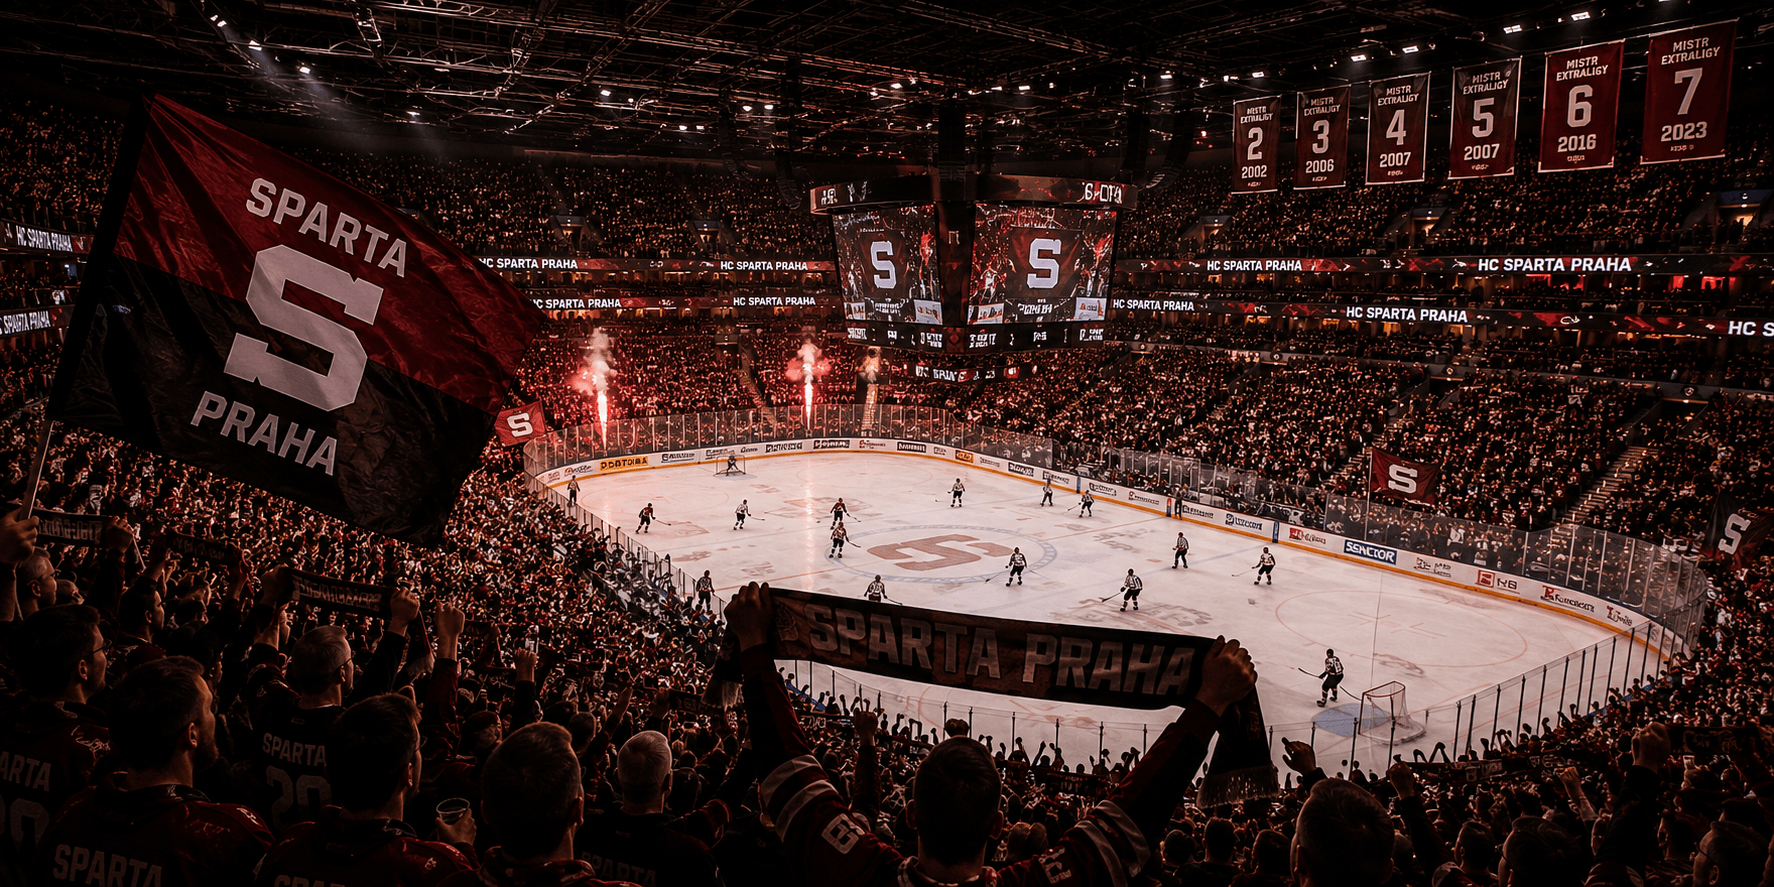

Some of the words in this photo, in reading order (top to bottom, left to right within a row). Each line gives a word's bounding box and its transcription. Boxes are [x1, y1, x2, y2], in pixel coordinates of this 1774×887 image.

[1672, 37, 1710, 52] MISTR
[1566, 55, 1599, 70] MISTR
[1660, 46, 1721, 66] EXTRALIGY
[1385, 85, 1412, 97] MISTR
[1674, 67, 1703, 115] 7
[1566, 84, 1594, 128] 6
[1385, 109, 1407, 146] 4
[1471, 97, 1495, 138] 5
[1311, 119, 1330, 154] 3
[1660, 121, 1708, 142] 2023
[1247, 126, 1264, 161] 2
[1463, 143, 1500, 161] 2007
[1557, 134, 1597, 153] 2016
[1305, 159, 1335, 174] 2006
[1379, 152, 1412, 168] 2007
[1241, 165, 1267, 179] 2002
[245, 177, 408, 278] SPARTA
[496, 258, 539, 269] SPARTA
[541, 258, 579, 269] PRAHA
[720, 261, 735, 270] HC
[736, 261, 774, 270] SPARTA
[775, 261, 808, 271] PRAHA
[870, 240, 897, 289] S
[1026, 238, 1062, 289] S
[1206, 260, 1221, 271] HC
[1222, 260, 1263, 271] SPARTA
[1265, 260, 1302, 271] PRAHA
[1478, 258, 1500, 271] HC
[1503, 257, 1566, 272] SPARTA
[1570, 257, 1632, 272] PRAHA
[545, 299, 585, 309] SPARTA
[588, 298, 621, 309] PRAHA
[733, 297, 746, 306] HC
[748, 297, 783, 306] SPARTA
[785, 296, 816, 306] PRAHA
[1112, 299, 1126, 309] HC
[1127, 299, 1162, 311] SPARTA
[1162, 300, 1195, 311] PRAHA
[1346, 306, 1364, 318] HC
[1366, 306, 1417, 321] SPARTA
[1419, 308, 1468, 323] PRAHA
[223, 244, 384, 412] S
[1728, 320, 1757, 336] HC
[190, 390, 339, 477] PRAHA
[506, 411, 534, 438] S
[1388, 463, 1419, 494] S
[1717, 513, 1752, 555] S
[803, 603, 1001, 679] SPARTA
[1022, 632, 1196, 696] PRAHA
[262, 732, 327, 767] SPARTA
[53, 843, 162, 887] SPARTA
